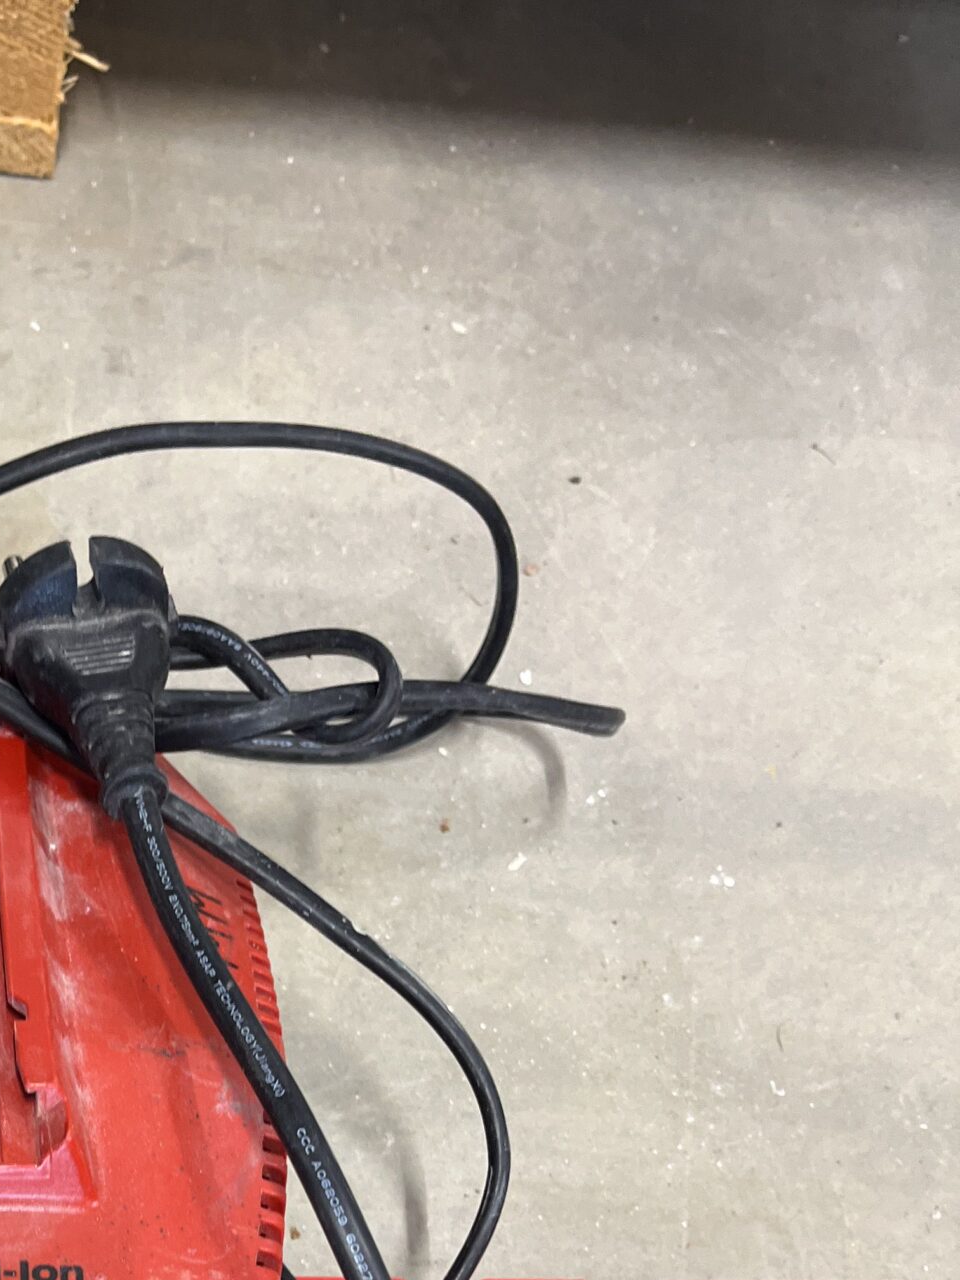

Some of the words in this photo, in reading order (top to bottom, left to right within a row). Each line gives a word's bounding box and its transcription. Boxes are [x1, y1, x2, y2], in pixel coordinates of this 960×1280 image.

[196, 950, 216, 978] ASAP
[296, 1127, 315, 1155] CCC
[312, 1160, 348, 1226] A062059
